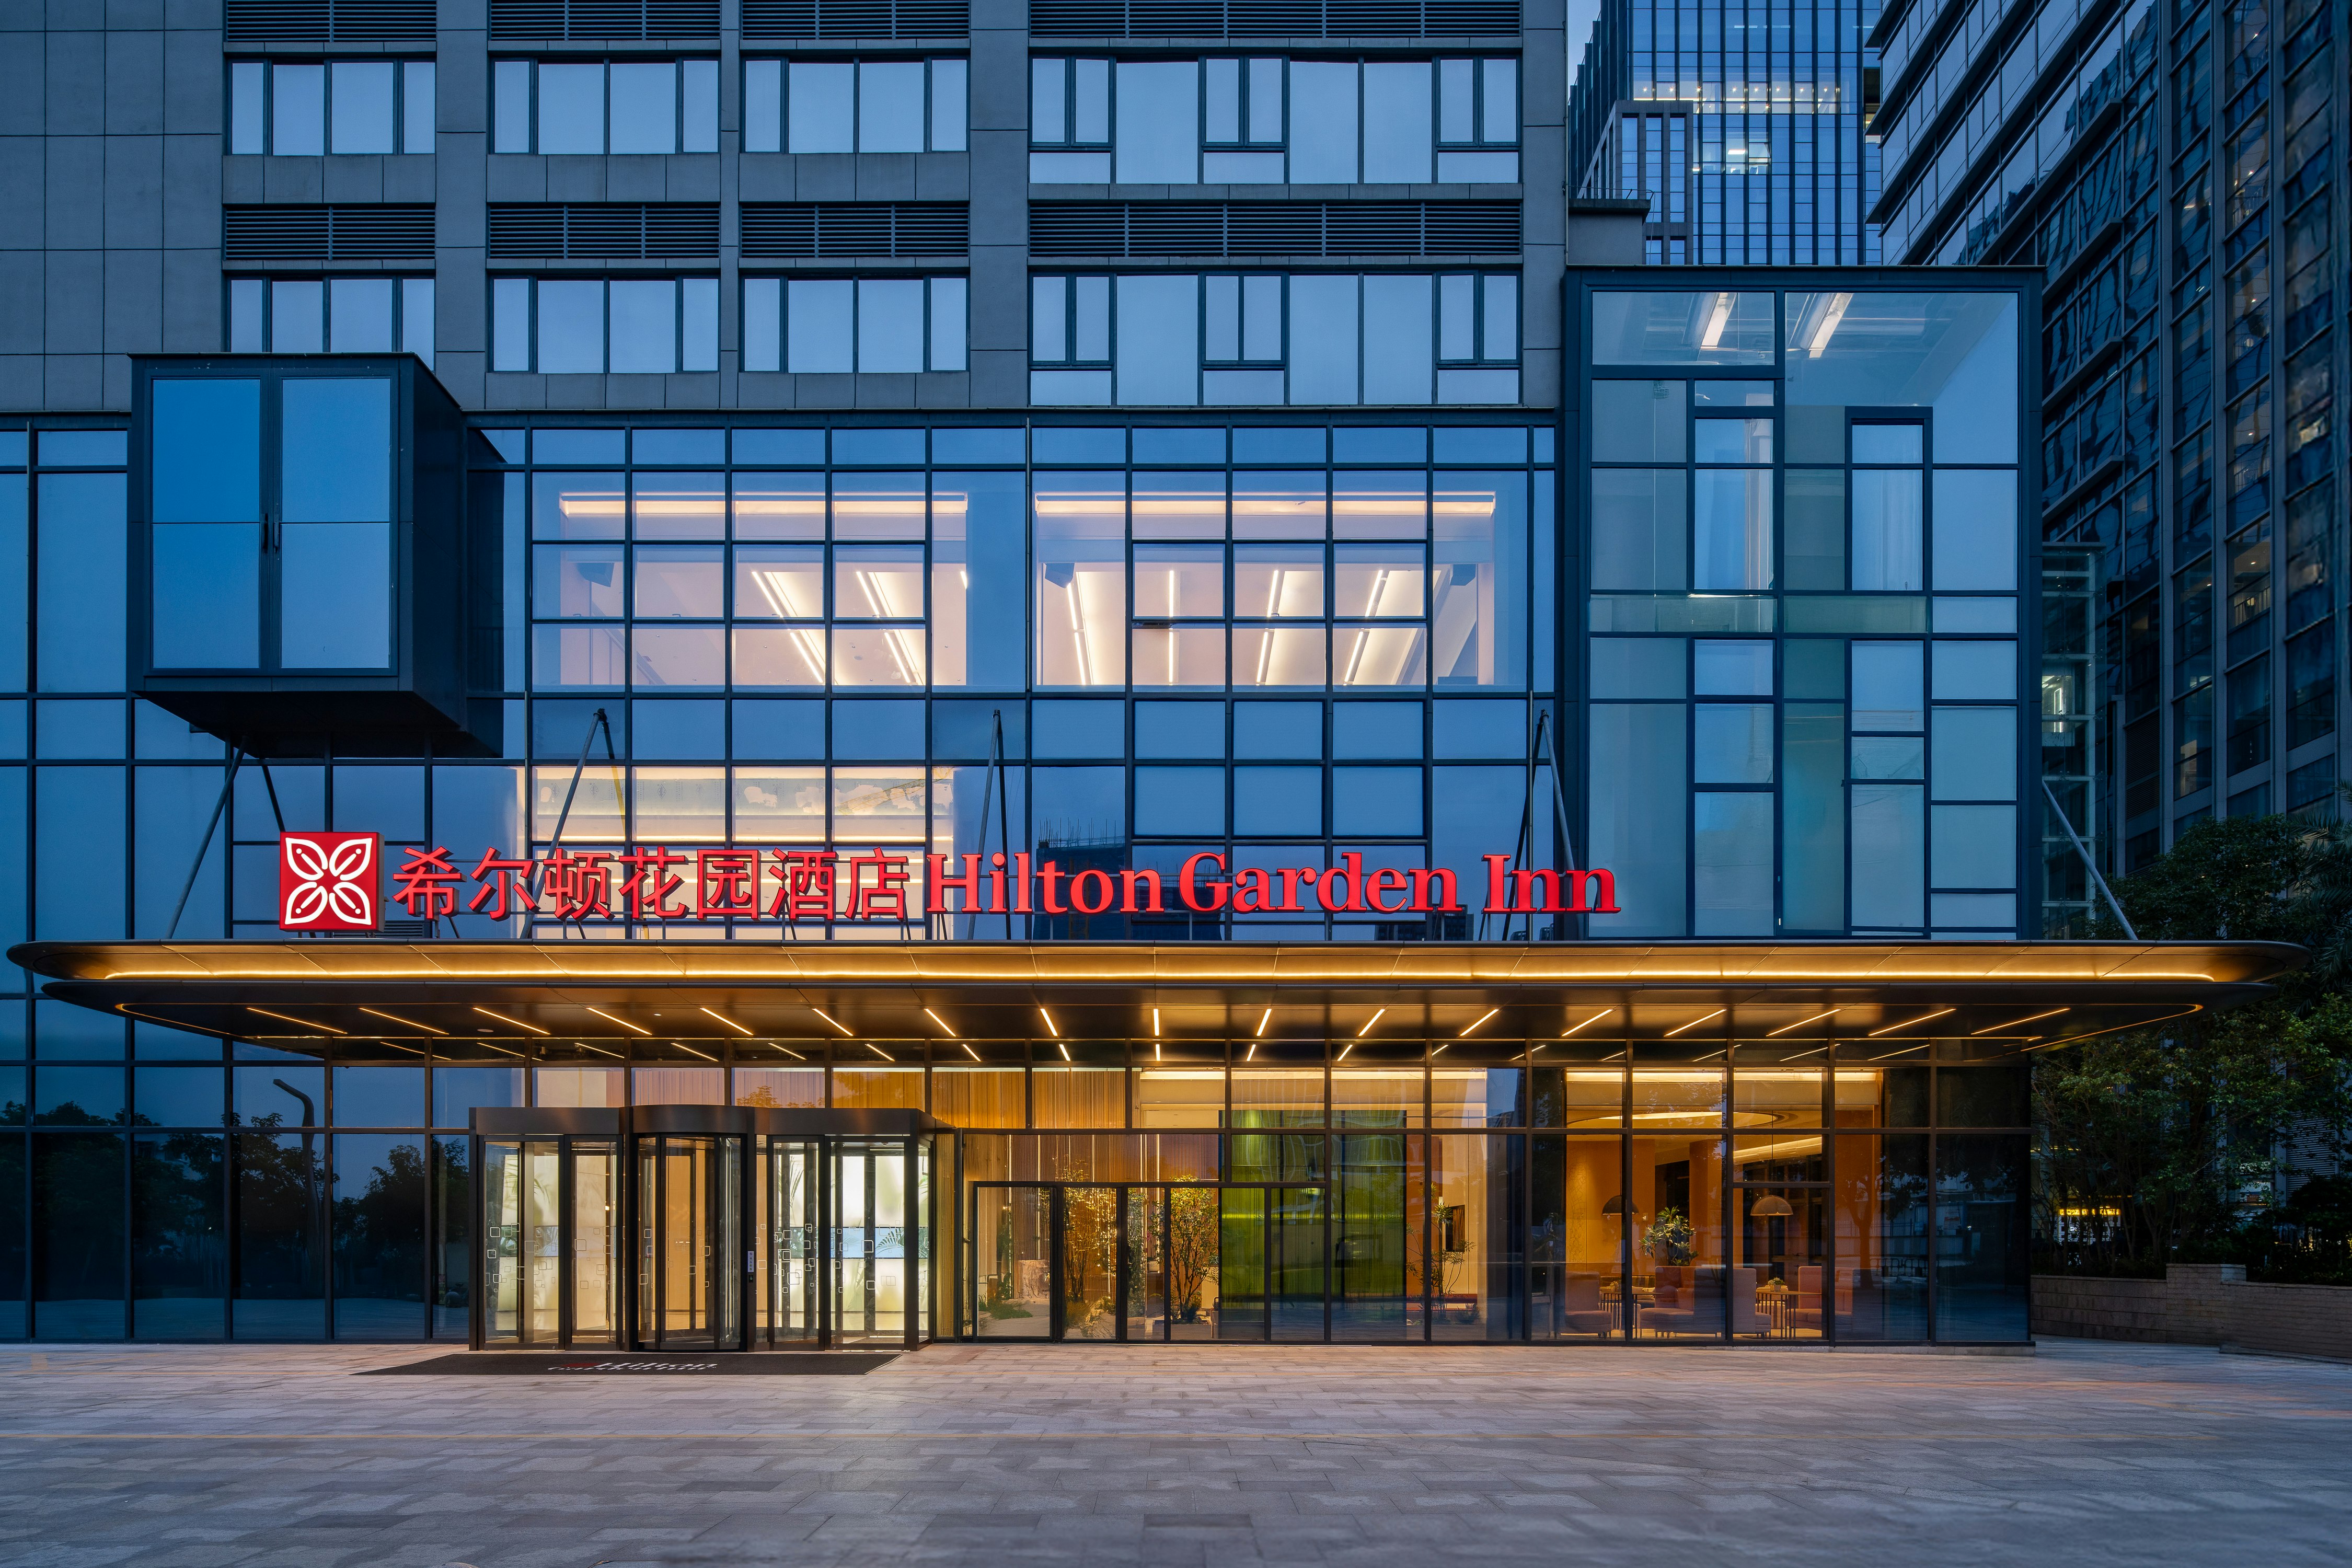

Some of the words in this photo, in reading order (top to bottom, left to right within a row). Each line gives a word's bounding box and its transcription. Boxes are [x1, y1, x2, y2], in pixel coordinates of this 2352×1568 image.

[392, 846, 909, 920] 希尔顿花园酒店
[926, 852, 1165, 914] Hilton
[1179, 851, 1463, 913] Garden
[1481, 854, 1621, 914] Inn
